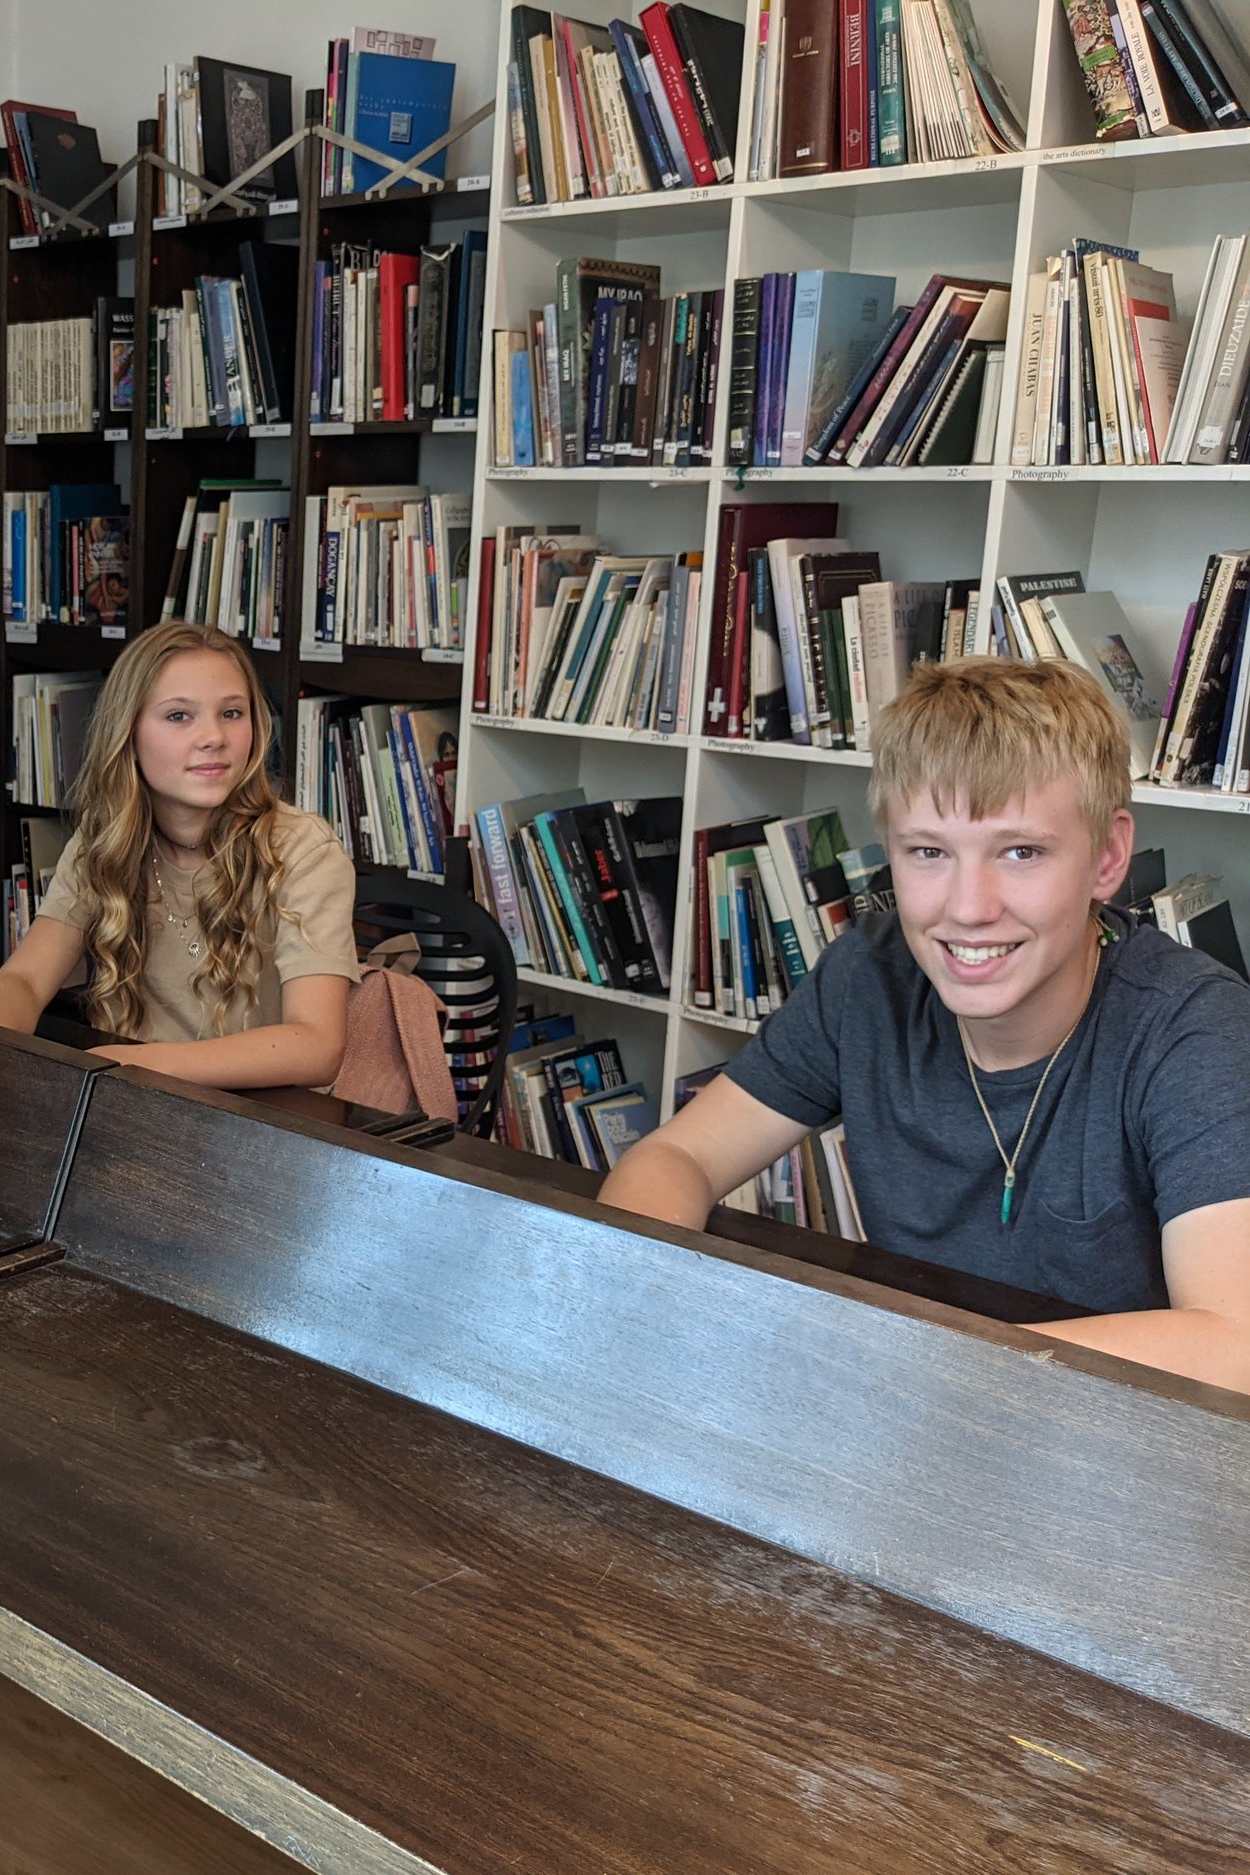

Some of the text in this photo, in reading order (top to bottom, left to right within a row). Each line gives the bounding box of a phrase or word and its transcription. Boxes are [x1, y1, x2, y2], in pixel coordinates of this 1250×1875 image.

[850, 14, 861, 67] BERNINI
[1131, 32, 1155, 97] LA VOIE ROYALE
[1043, 147, 1107, 160] the arts dictionary
[975, 160, 997, 170] 22-B
[690, 189, 709, 200] 23-B
[1090, 262, 1103, 290] visual
[598, 286, 616, 299] MY
[1030, 313, 1042, 346] JUAN
[1219, 298, 1250, 377] DIEUZAIDE
[488, 467, 529, 478] Photography
[947, 468, 969, 477] 22-C
[1012, 469, 1069, 479] Photography
[1019, 577, 1077, 592] PALESTINE
[865, 603, 879, 659] PICASSO
[1182, 674, 1198, 705] POLSKA
[475, 716, 515, 727] Photography
[707, 739, 756, 751] Photography
[482, 809, 513, 904] fast forward
